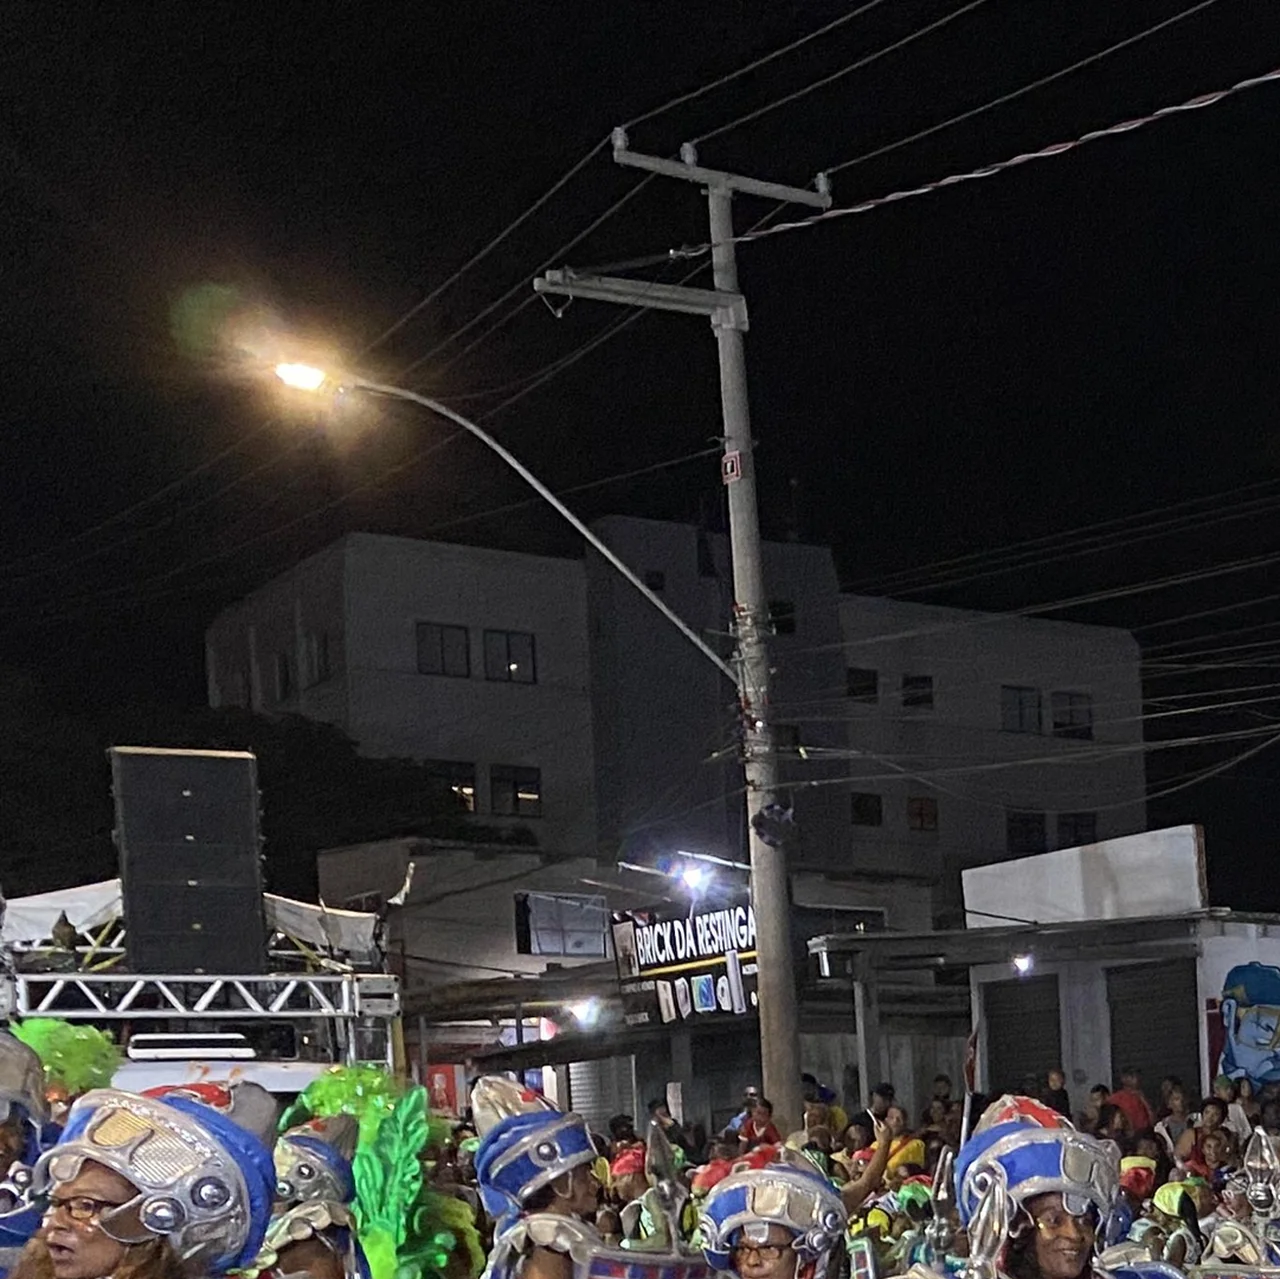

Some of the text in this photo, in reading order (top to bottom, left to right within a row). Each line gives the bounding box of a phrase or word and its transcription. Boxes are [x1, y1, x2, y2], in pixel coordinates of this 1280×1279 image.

[636, 905, 757, 966] BRICK DA RESTINGA
